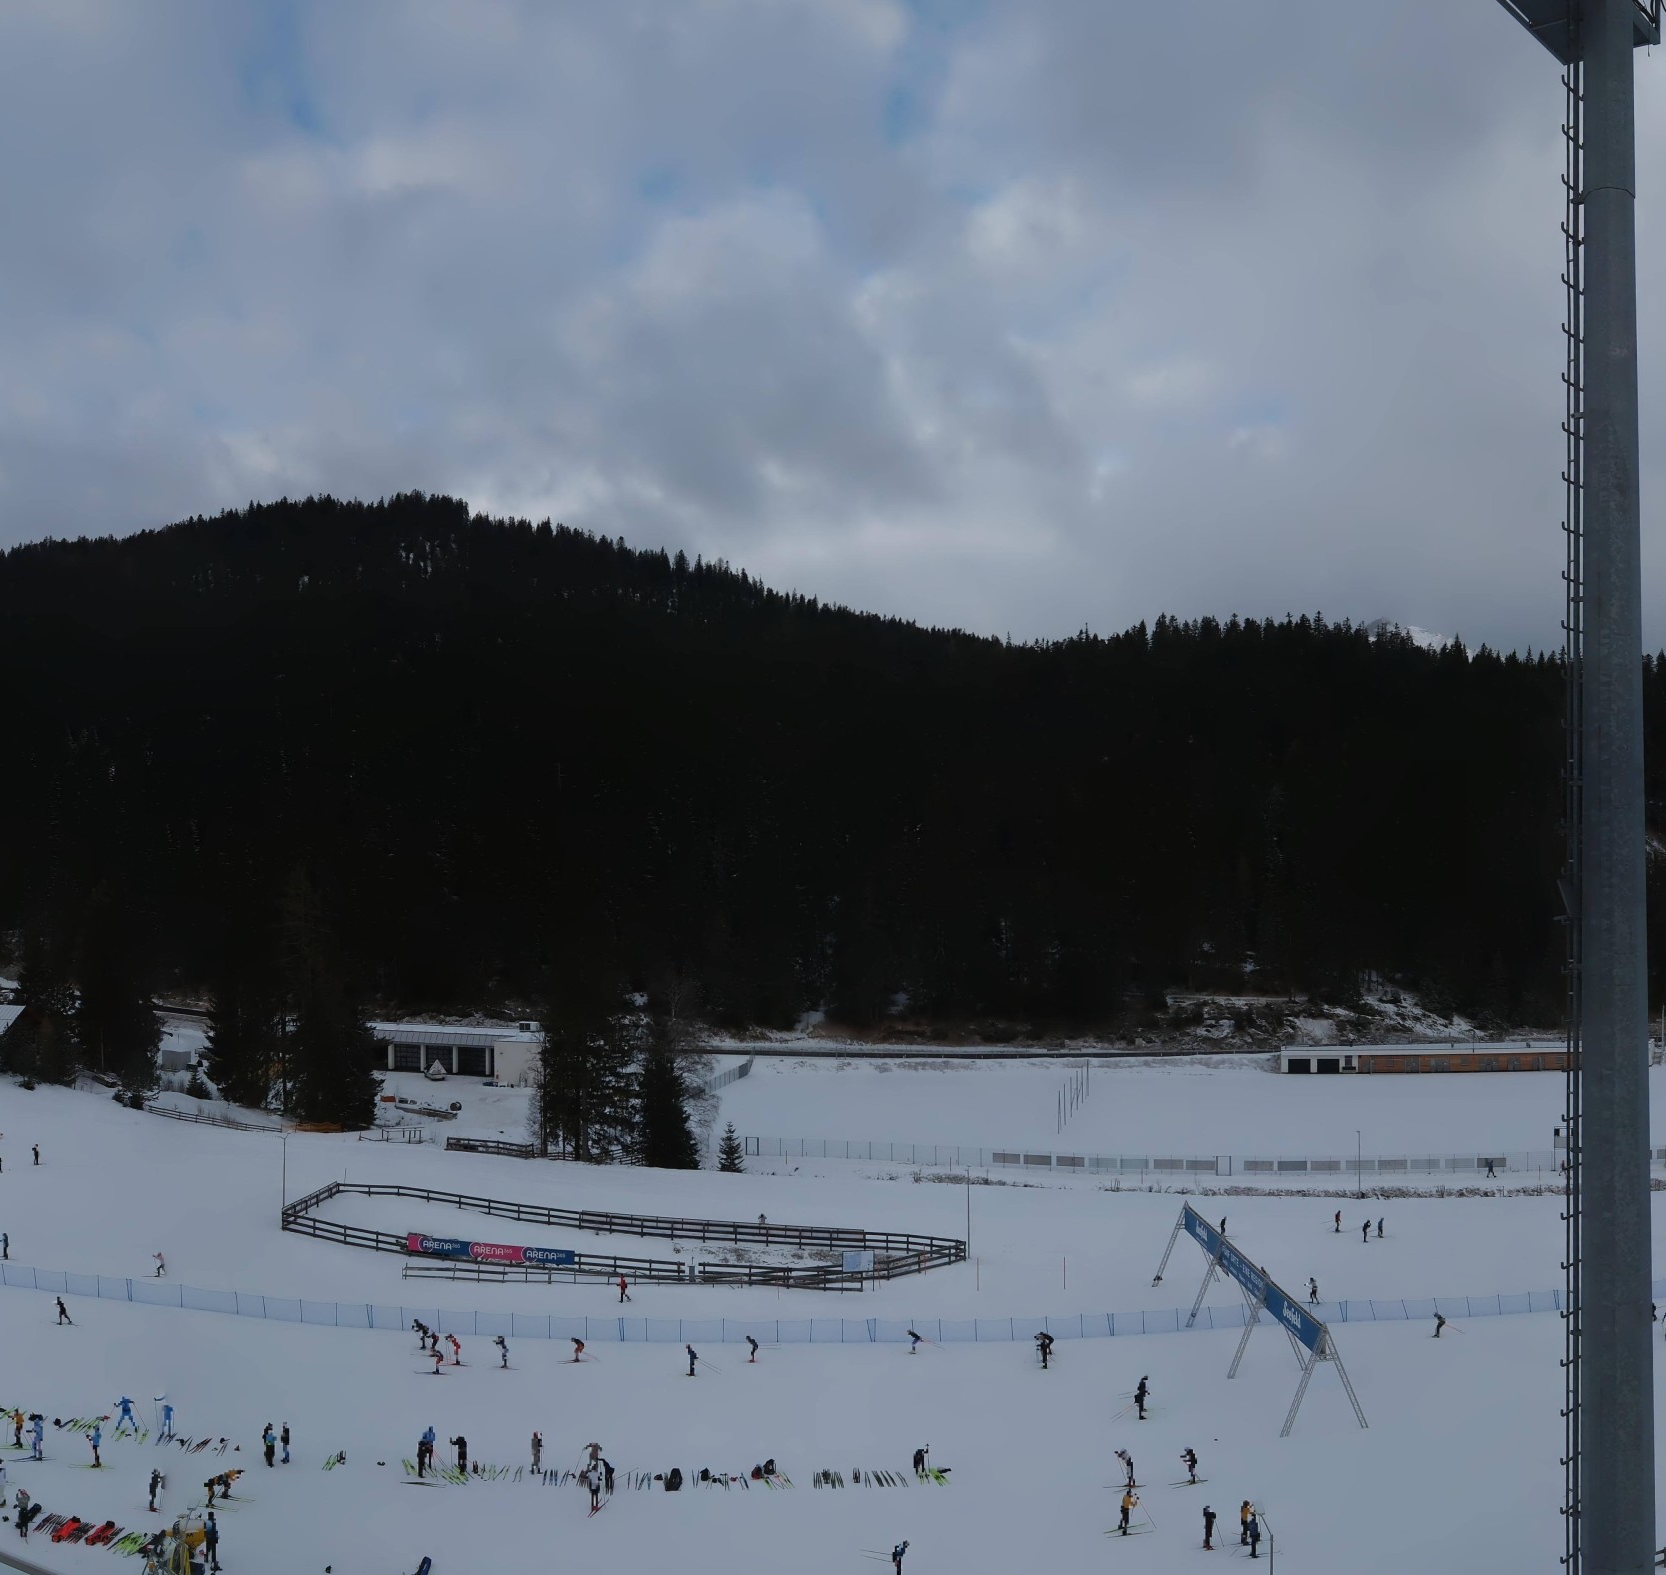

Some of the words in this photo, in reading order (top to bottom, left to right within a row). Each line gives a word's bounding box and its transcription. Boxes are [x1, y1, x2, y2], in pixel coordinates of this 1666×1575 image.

[422, 1240, 452, 1251] ARENA
[473, 1245, 504, 1256] ARENA
[526, 1250, 557, 1260] ARENA
[1283, 1300, 1301, 1329] Seefeld
